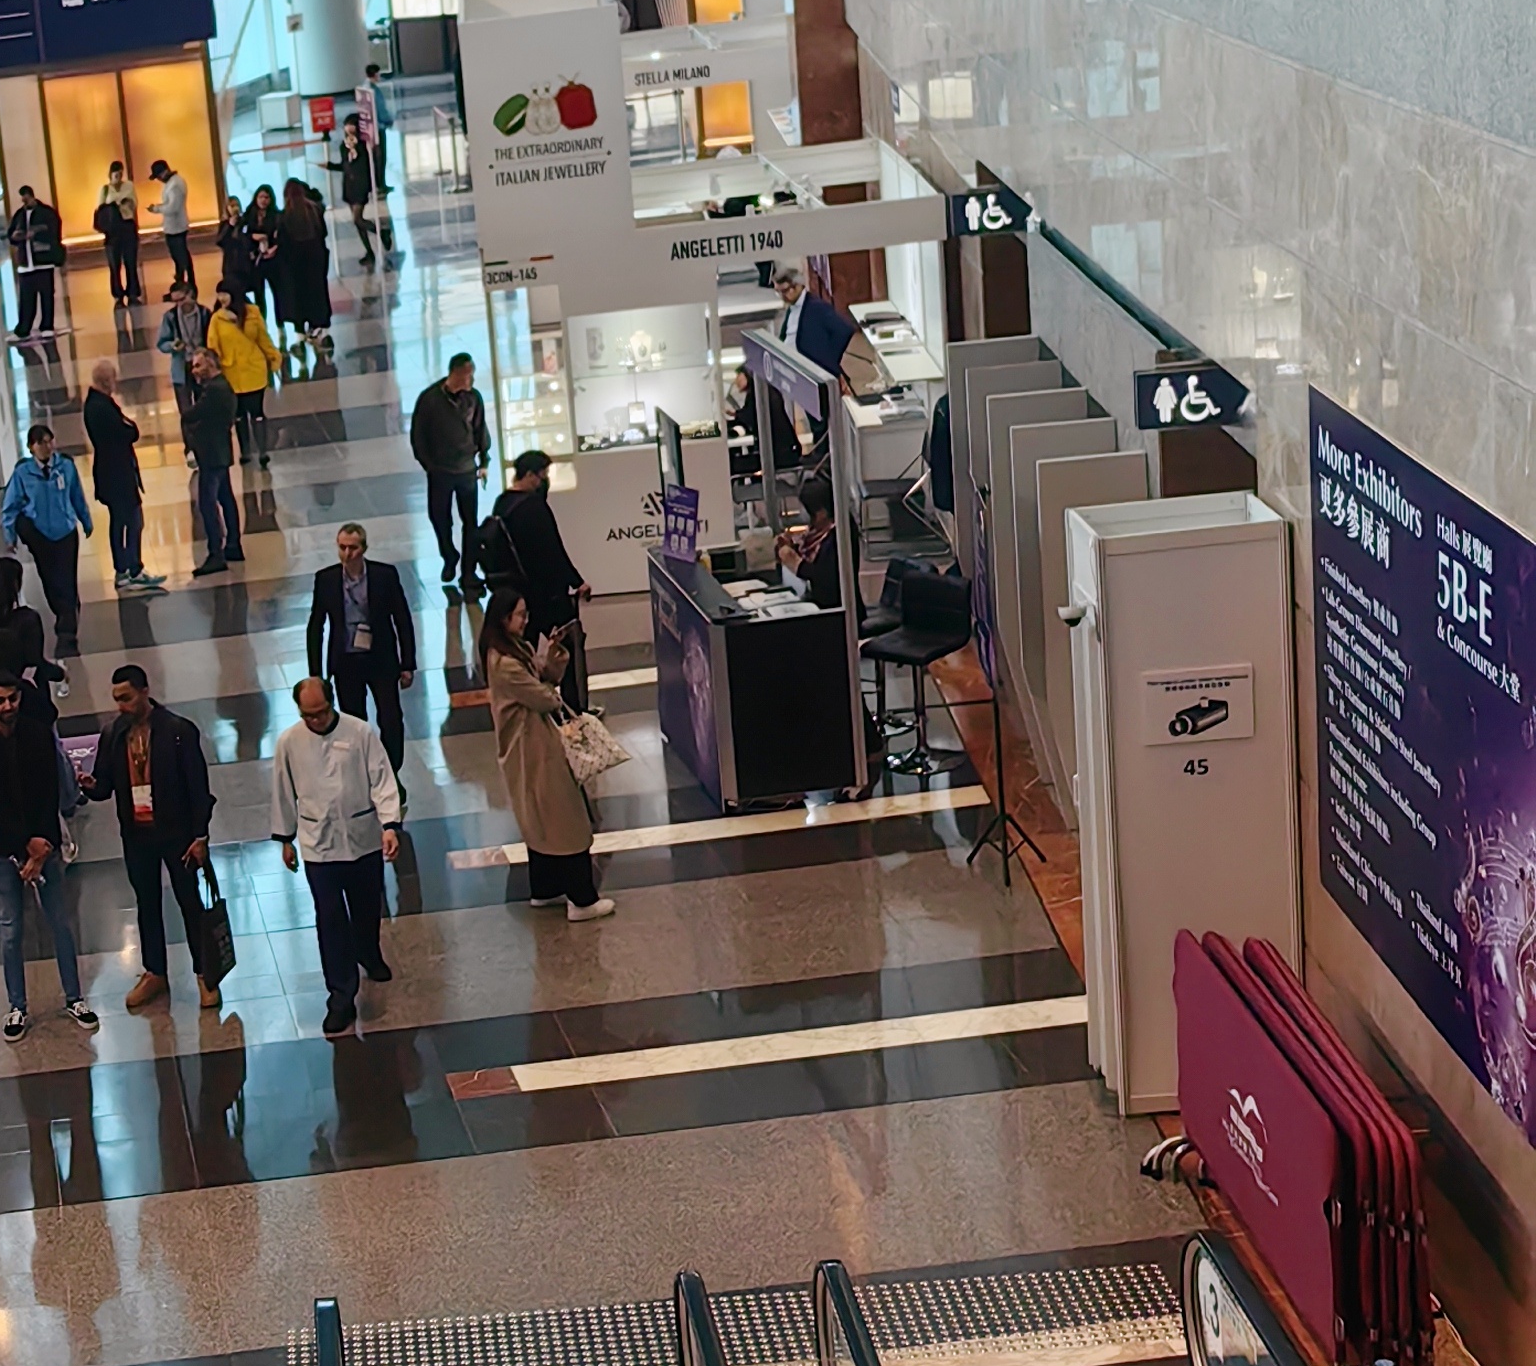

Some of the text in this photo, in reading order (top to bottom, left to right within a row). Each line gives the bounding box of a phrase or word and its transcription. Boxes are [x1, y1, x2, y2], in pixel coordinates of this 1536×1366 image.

[634, 65, 710, 86] STELLA MILANO
[494, 136, 604, 161] THE EXTRAORDINARY
[495, 160, 607, 187] ITALIAN JEWELLERY
[670, 230, 783, 261] ANGELETTI 1940
[1318, 424, 1423, 539] More Exhibitors
[606, 518, 709, 542] ANGELTI
[1318, 472, 1390, 569] 更多參展商
[1436, 513, 1461, 552] Halls
[1436, 549, 1493, 646] 5B-E
[1437, 615, 1521, 704] & Concourse 大堂
[1183, 758, 1209, 776] 45
